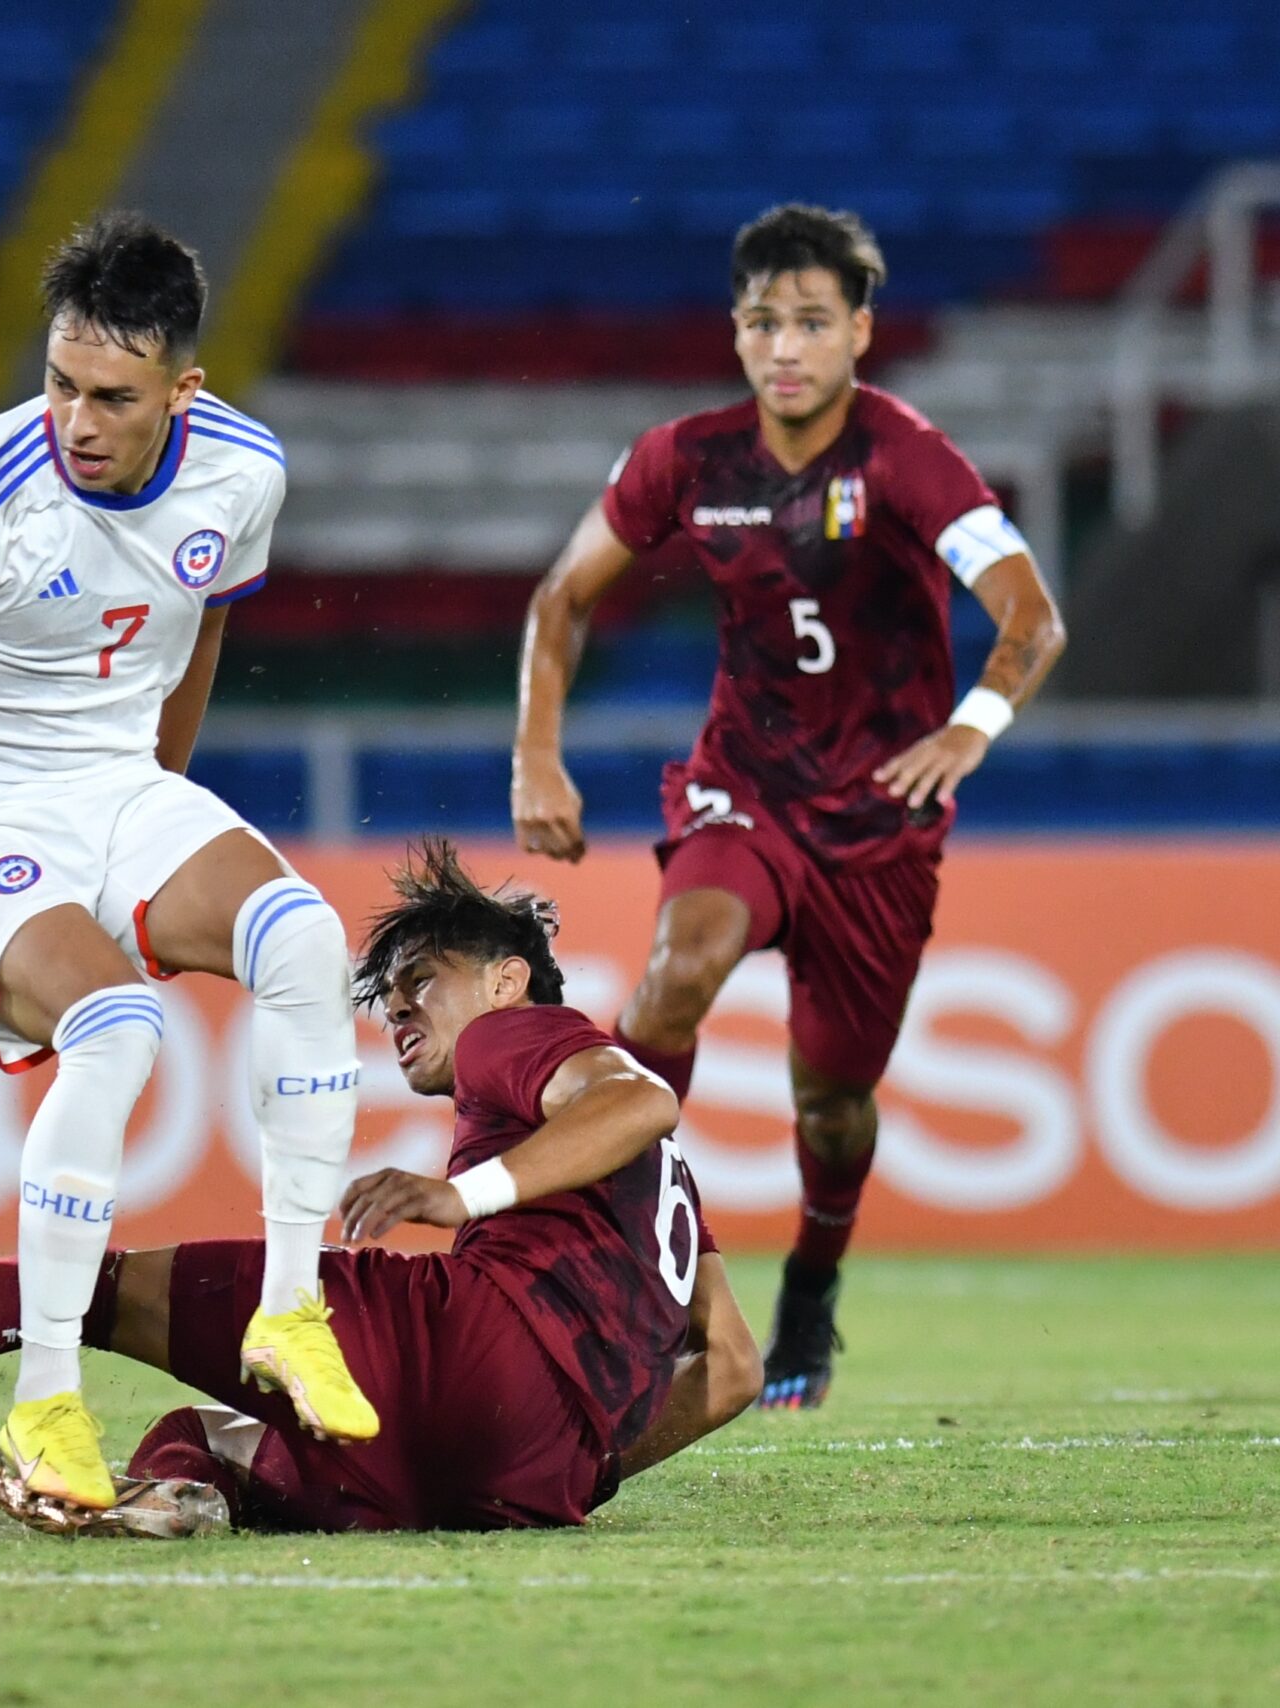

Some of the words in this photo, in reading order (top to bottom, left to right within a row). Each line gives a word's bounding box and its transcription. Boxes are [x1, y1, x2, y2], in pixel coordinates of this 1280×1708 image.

[97, 604, 150, 679] 7
[789, 599, 836, 674] 5
[23, 1181, 115, 1223] CHILE
[655, 1137, 699, 1307] 6
